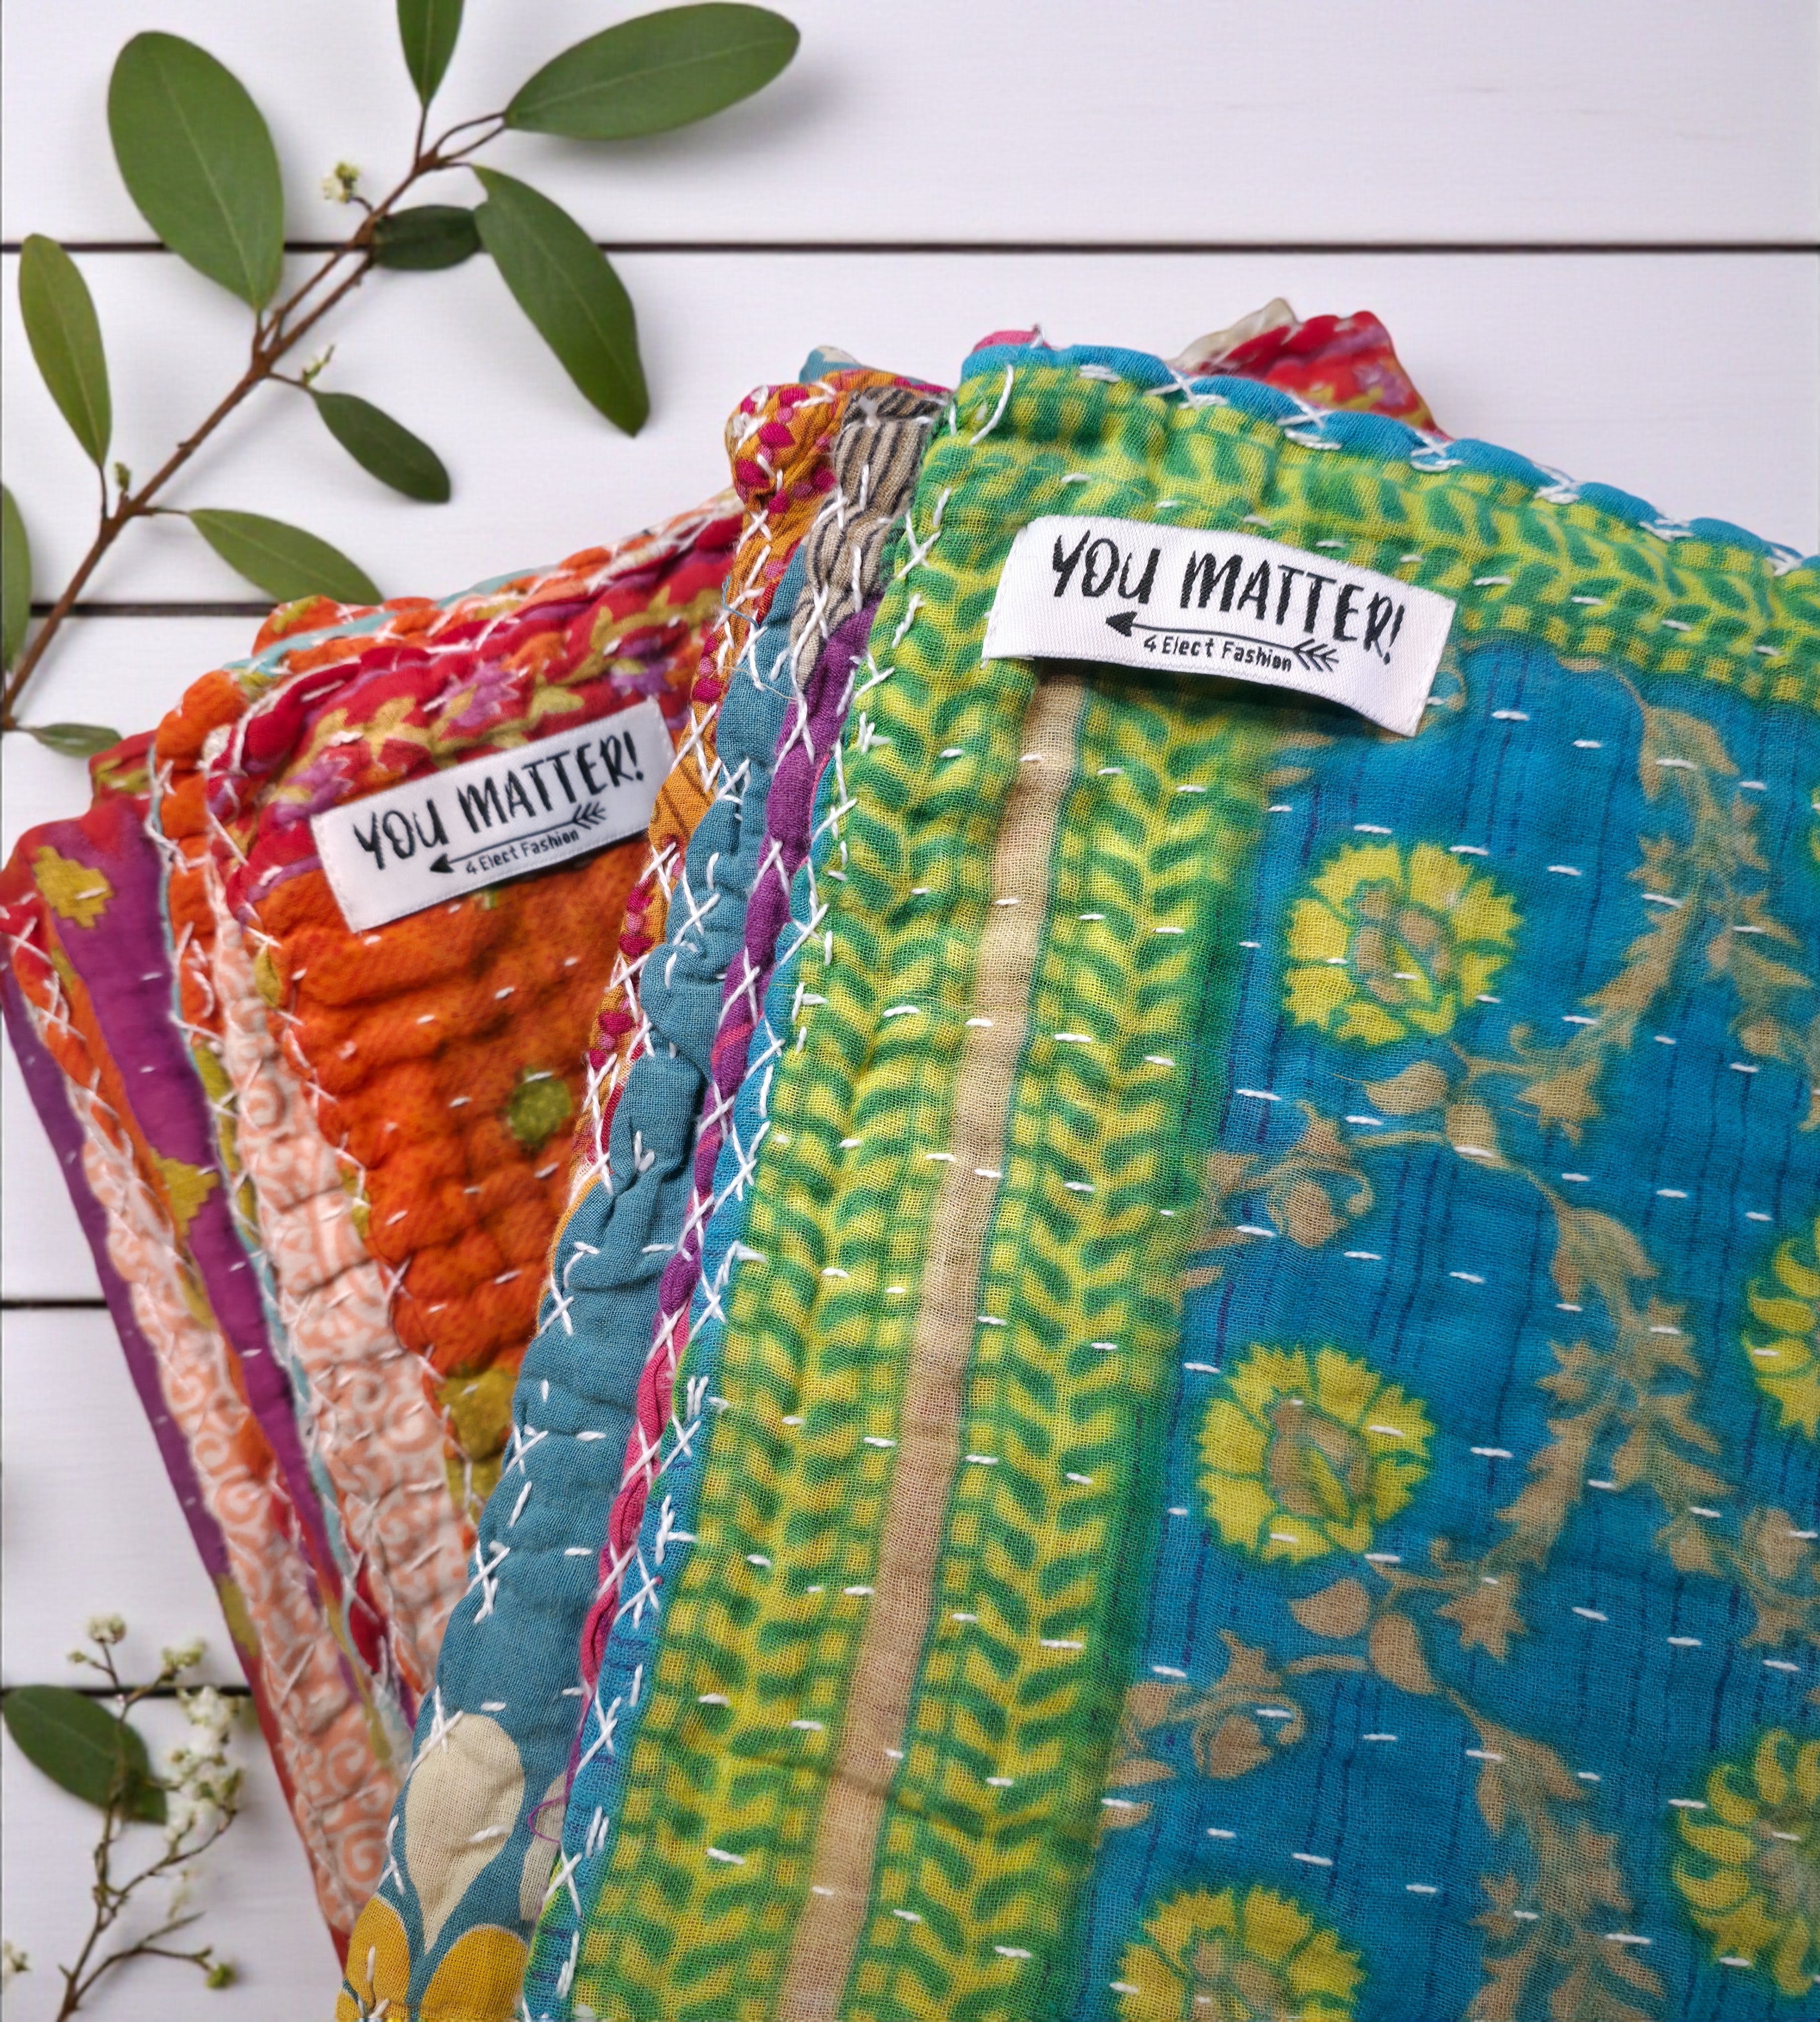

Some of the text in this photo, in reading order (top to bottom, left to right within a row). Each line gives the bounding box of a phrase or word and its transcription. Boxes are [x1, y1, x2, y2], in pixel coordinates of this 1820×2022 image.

[1052, 530, 1405, 664] YOU MATTER!
[1144, 635, 1291, 672] 4 Elect Fashion
[353, 731, 644, 870] YOU MATTER!
[466, 829, 580, 875] 4 Elect Fashion
